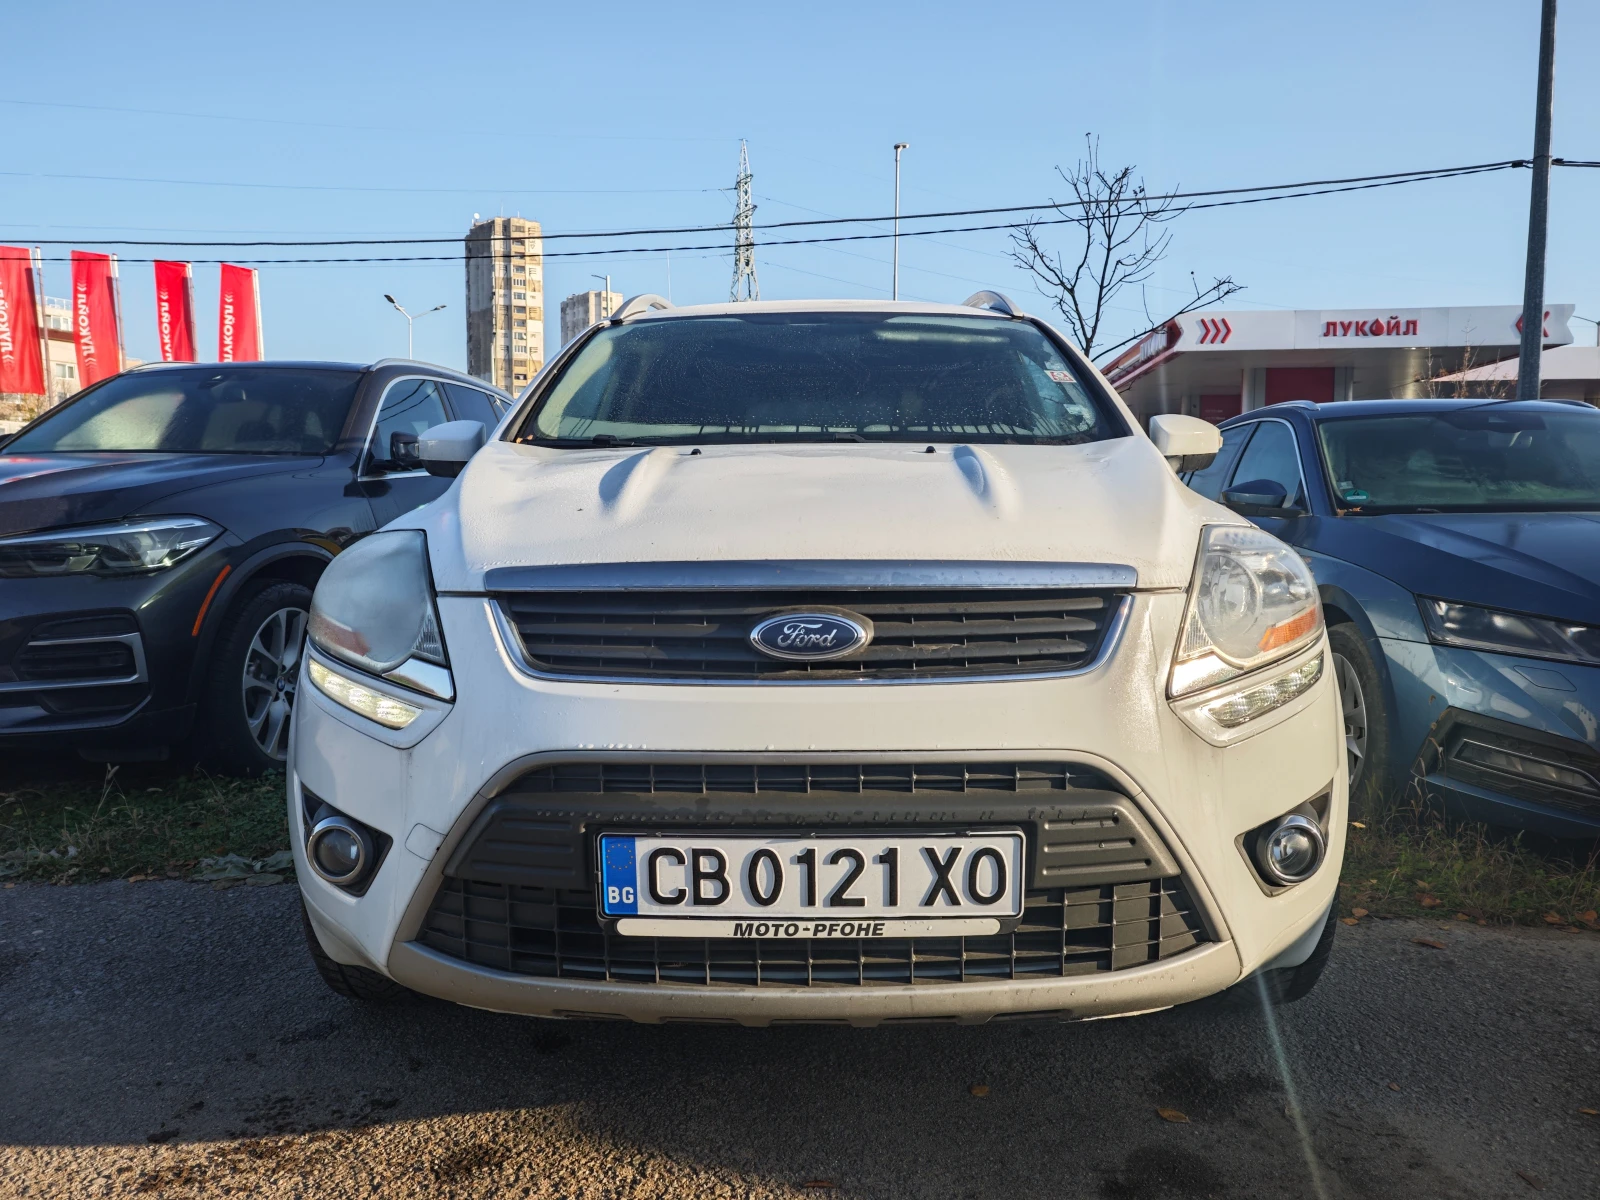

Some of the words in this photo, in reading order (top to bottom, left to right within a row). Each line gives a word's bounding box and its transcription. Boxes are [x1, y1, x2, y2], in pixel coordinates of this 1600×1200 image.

[777, 622, 838, 648] Ford
[747, 847, 899, 907] 0121
[608, 886, 635, 904] BG
[733, 922, 885, 937] MOTO-PFOHE
